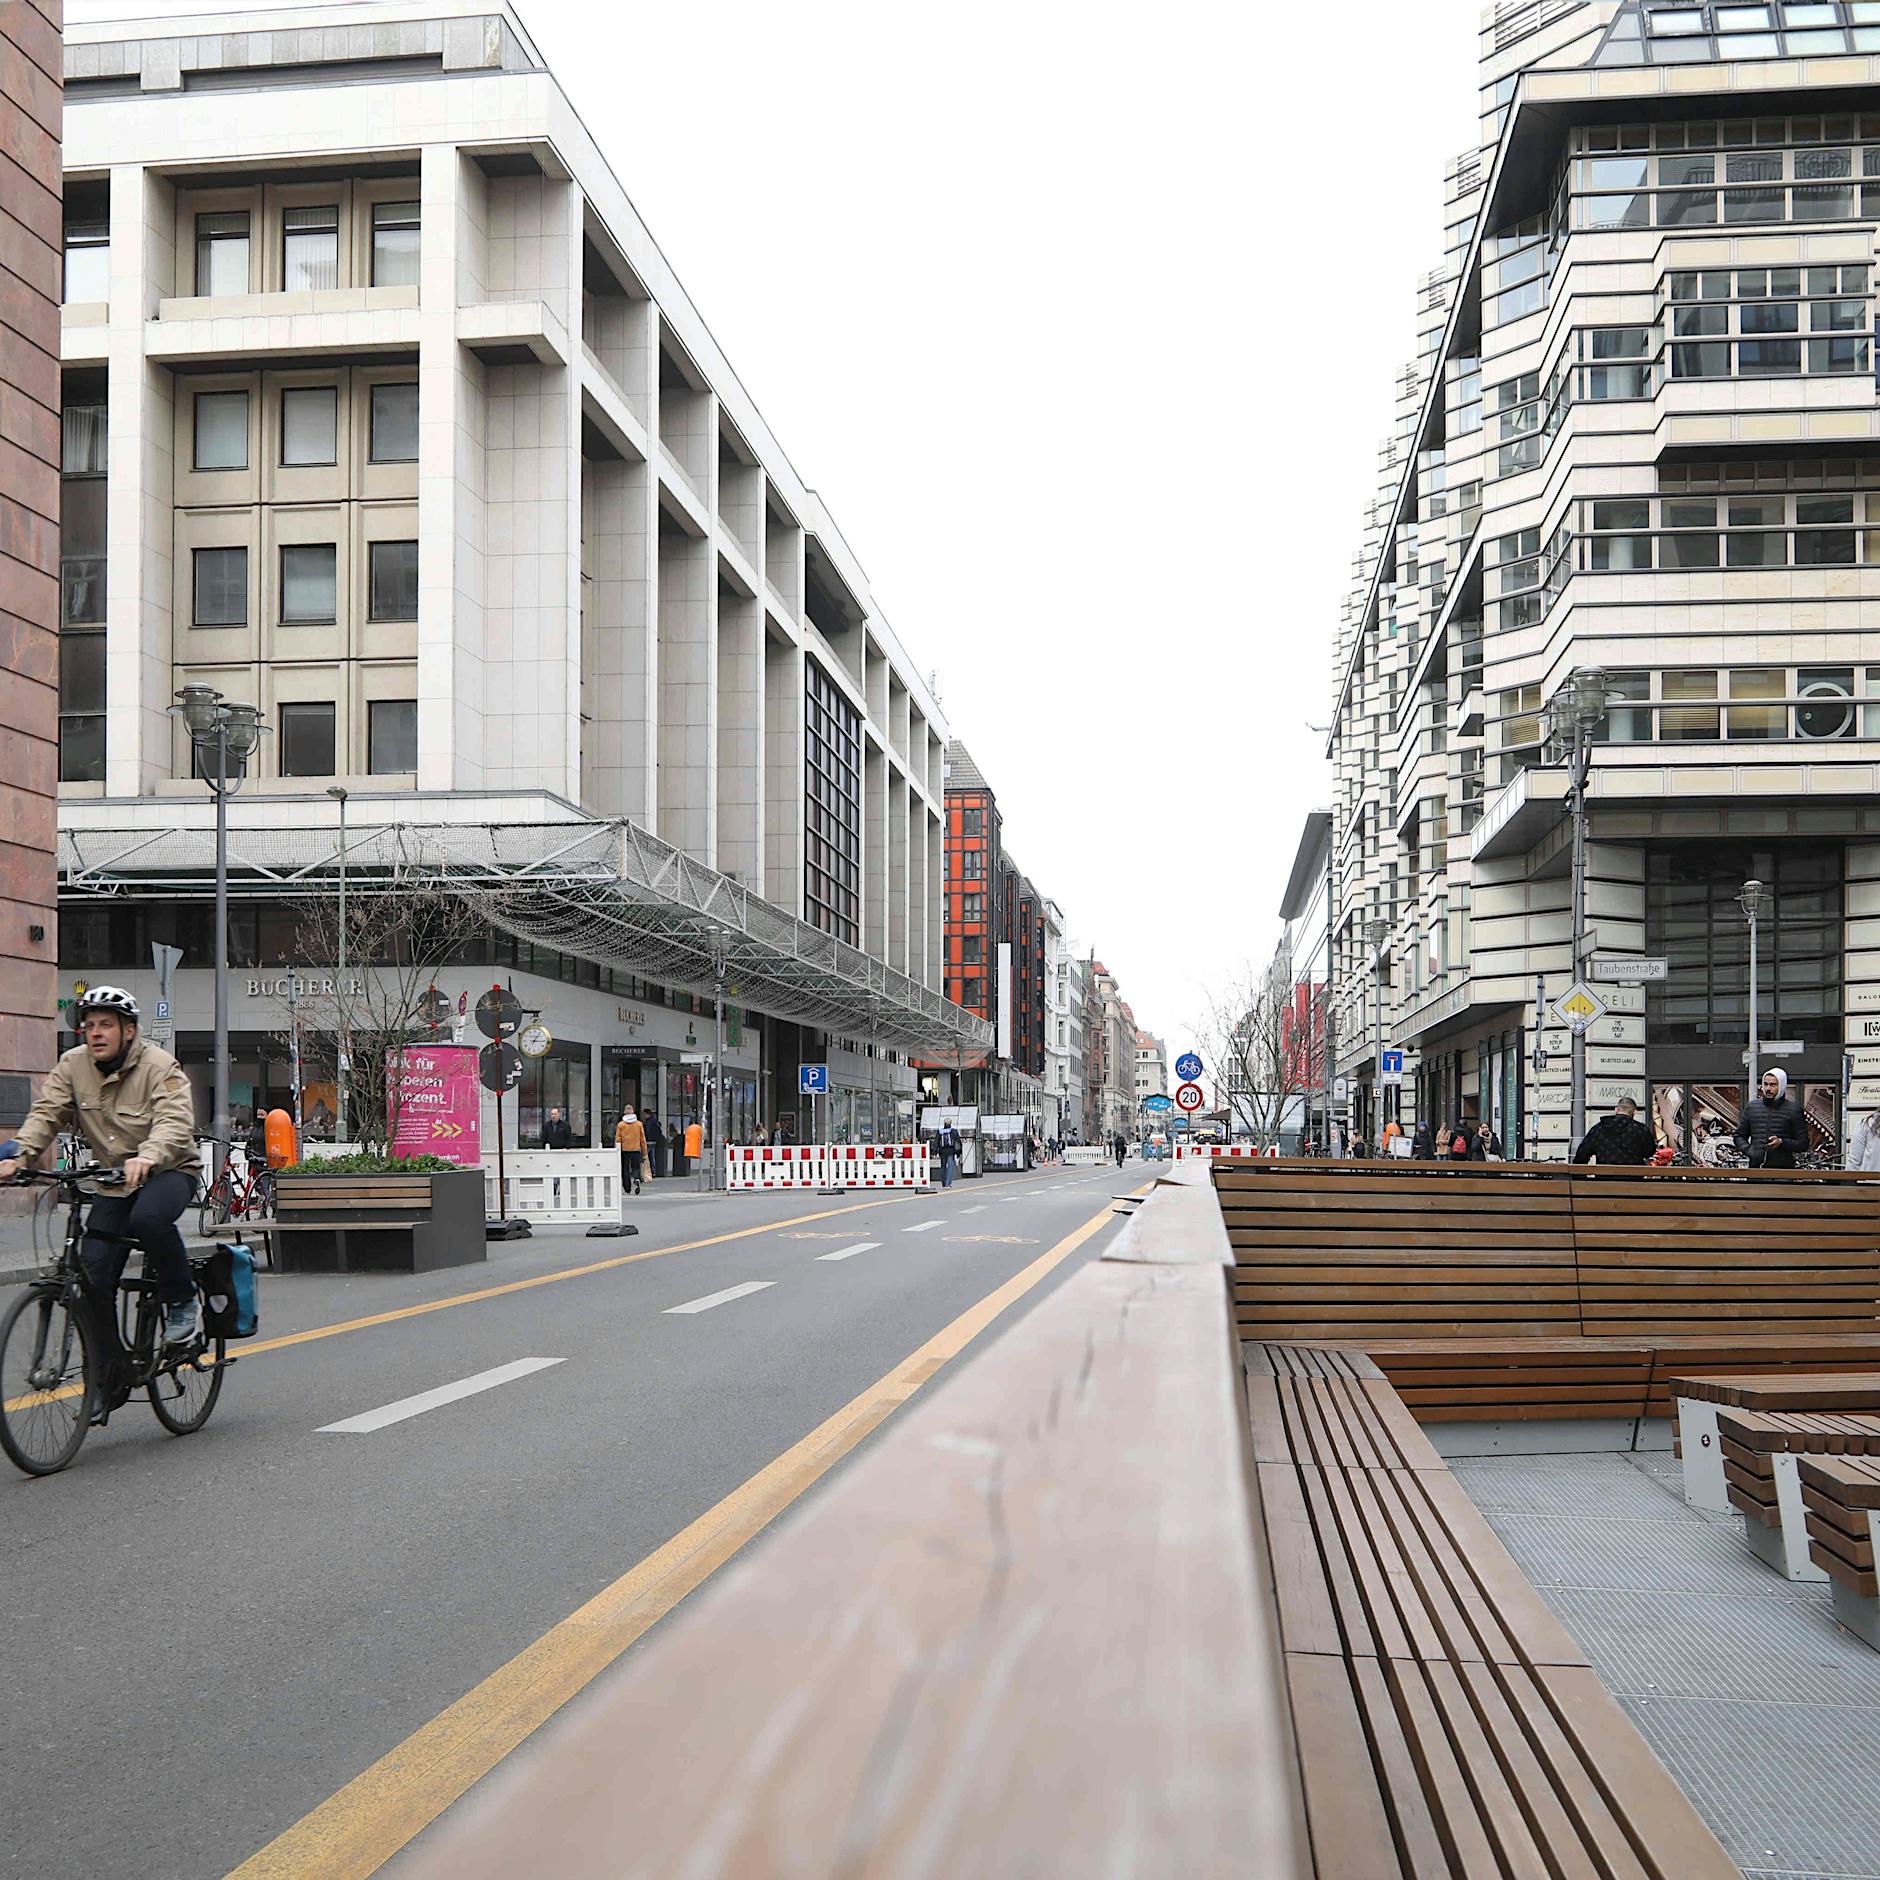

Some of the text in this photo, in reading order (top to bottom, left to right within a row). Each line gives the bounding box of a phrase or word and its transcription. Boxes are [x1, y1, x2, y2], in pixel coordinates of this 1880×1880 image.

[1599, 963, 1660, 976] Taubenstraße
[247, 979, 363, 996] BUCHERR
[416, 1056, 435, 1070] für
[809, 1070, 819, 1085] P
[1183, 1092, 1197, 1103] 20
